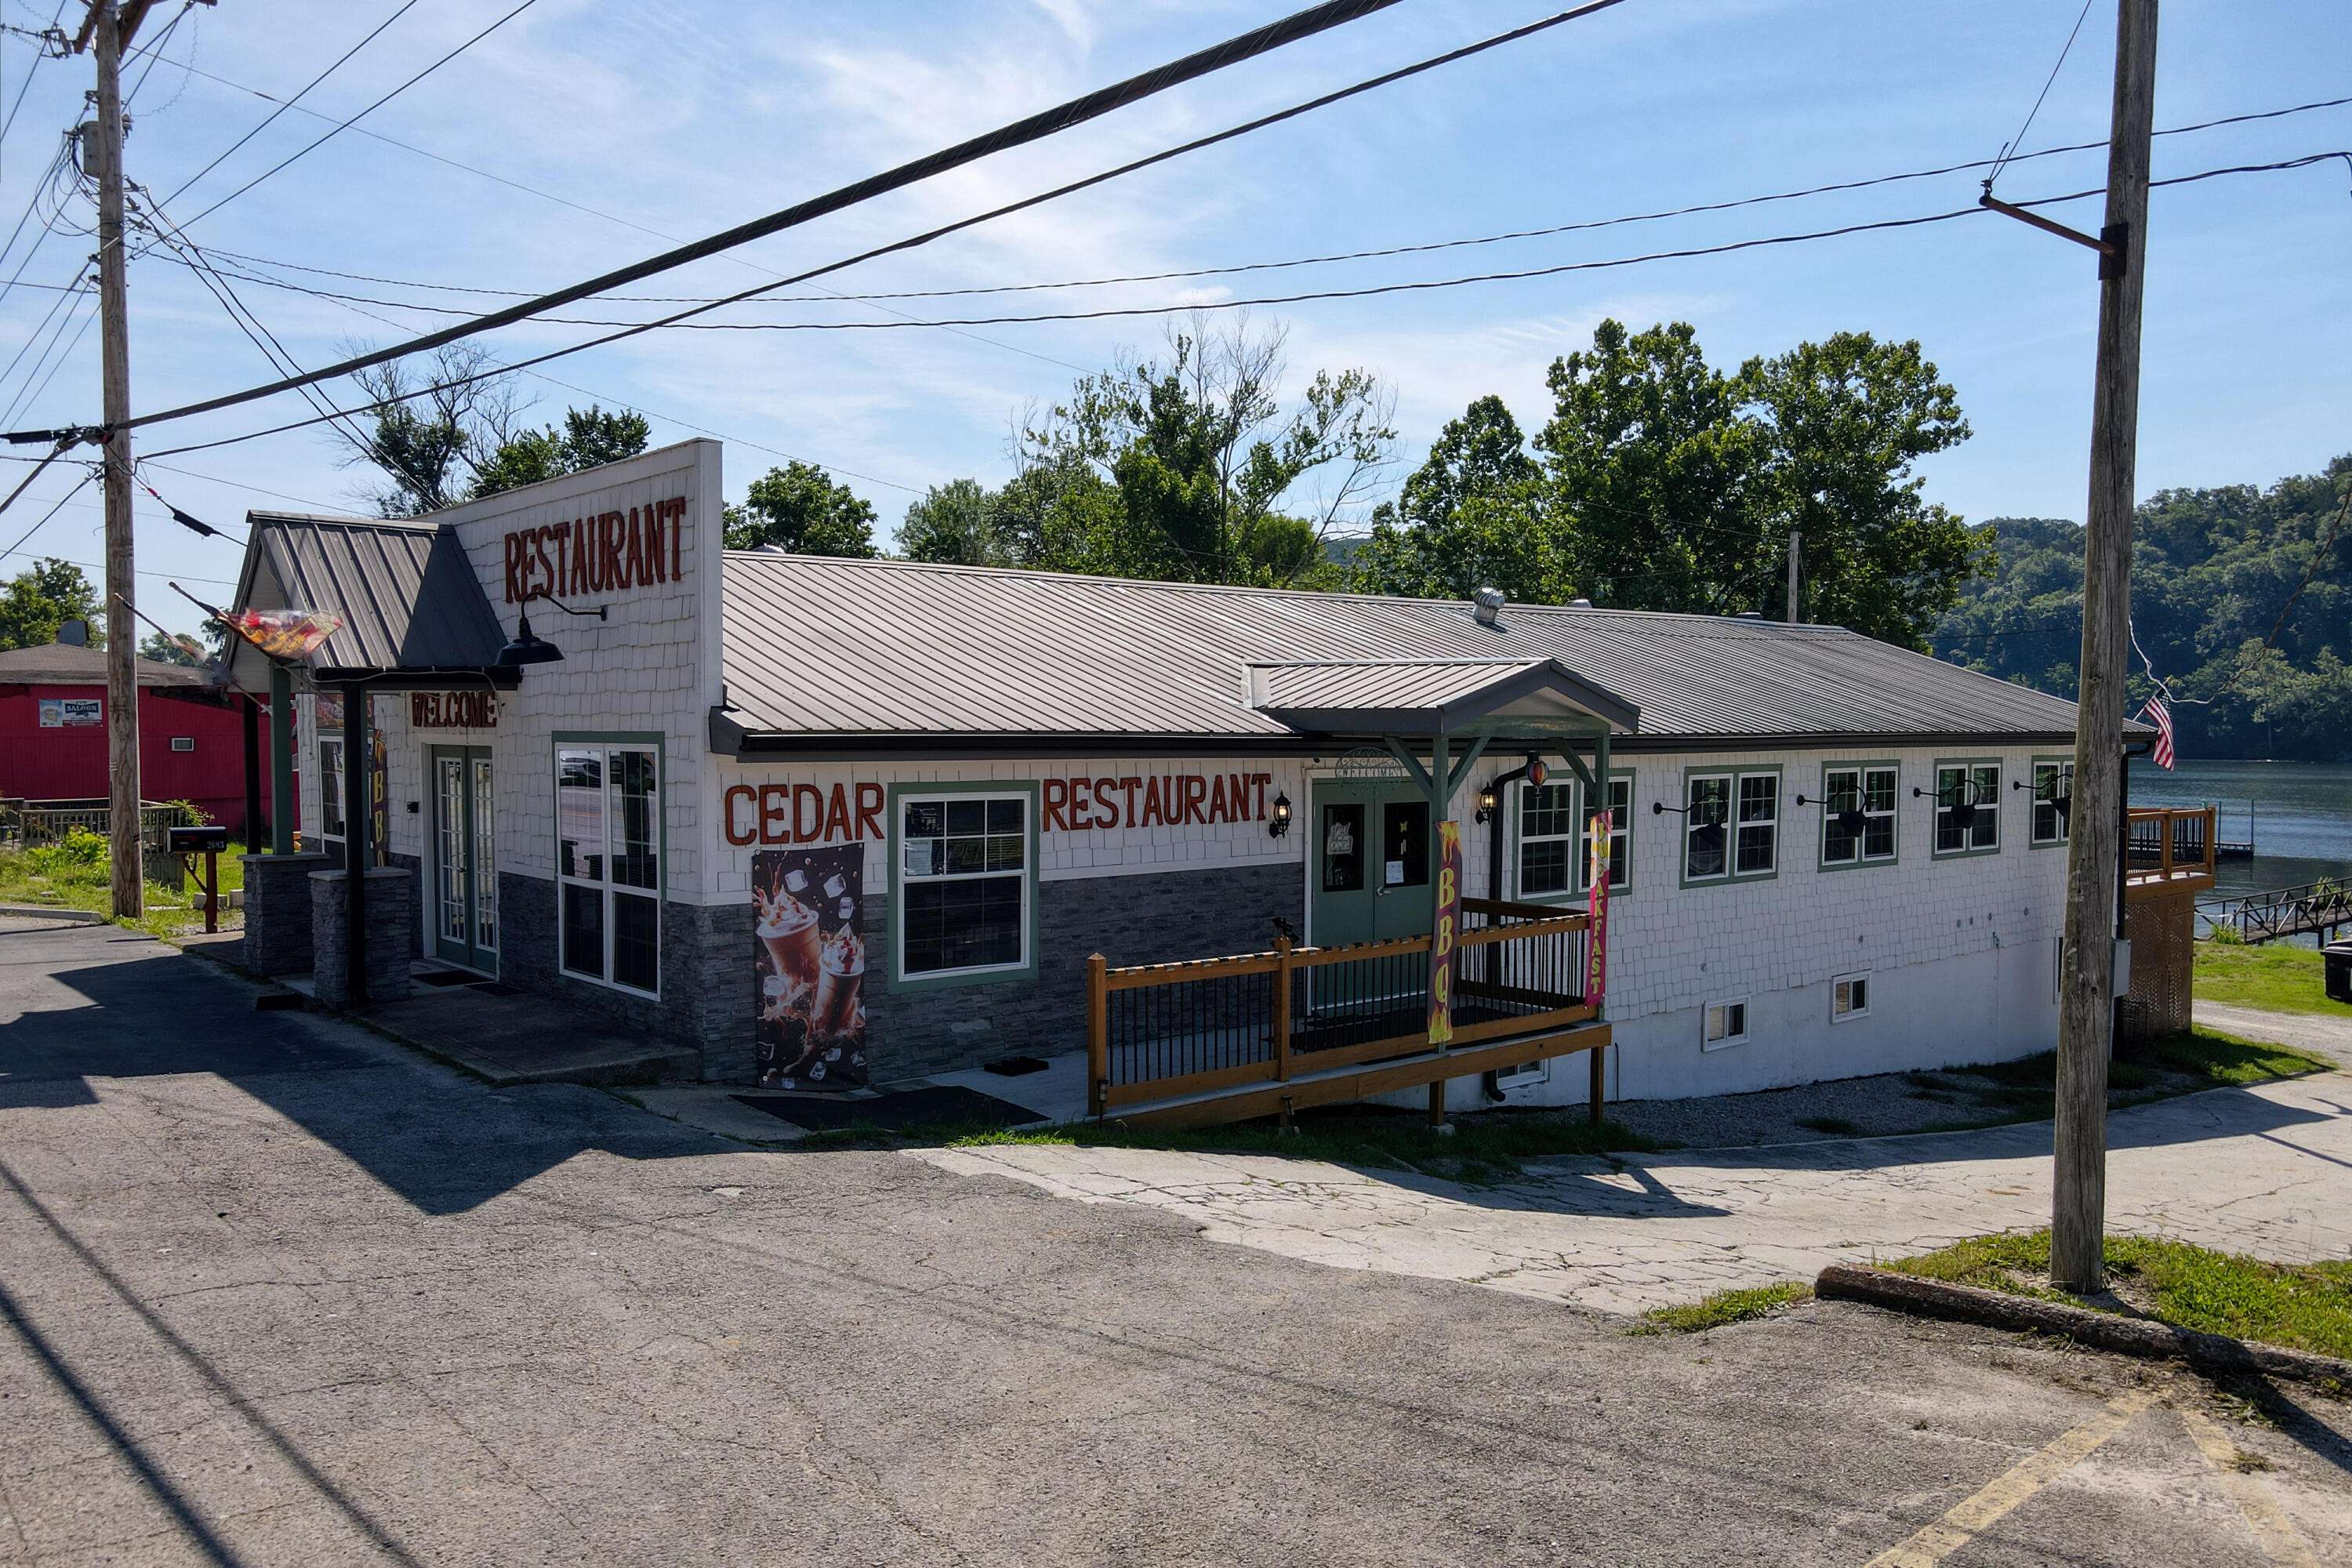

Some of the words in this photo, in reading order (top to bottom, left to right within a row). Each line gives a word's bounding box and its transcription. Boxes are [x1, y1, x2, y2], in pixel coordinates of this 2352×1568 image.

[504, 496, 686, 603] RESTAURANT
[411, 691, 497, 728] WELCOME
[725, 782, 885, 845] CEDAR
[1043, 773, 1272, 832] RESTAURANT
[1435, 866, 1455, 1006] BBQ
